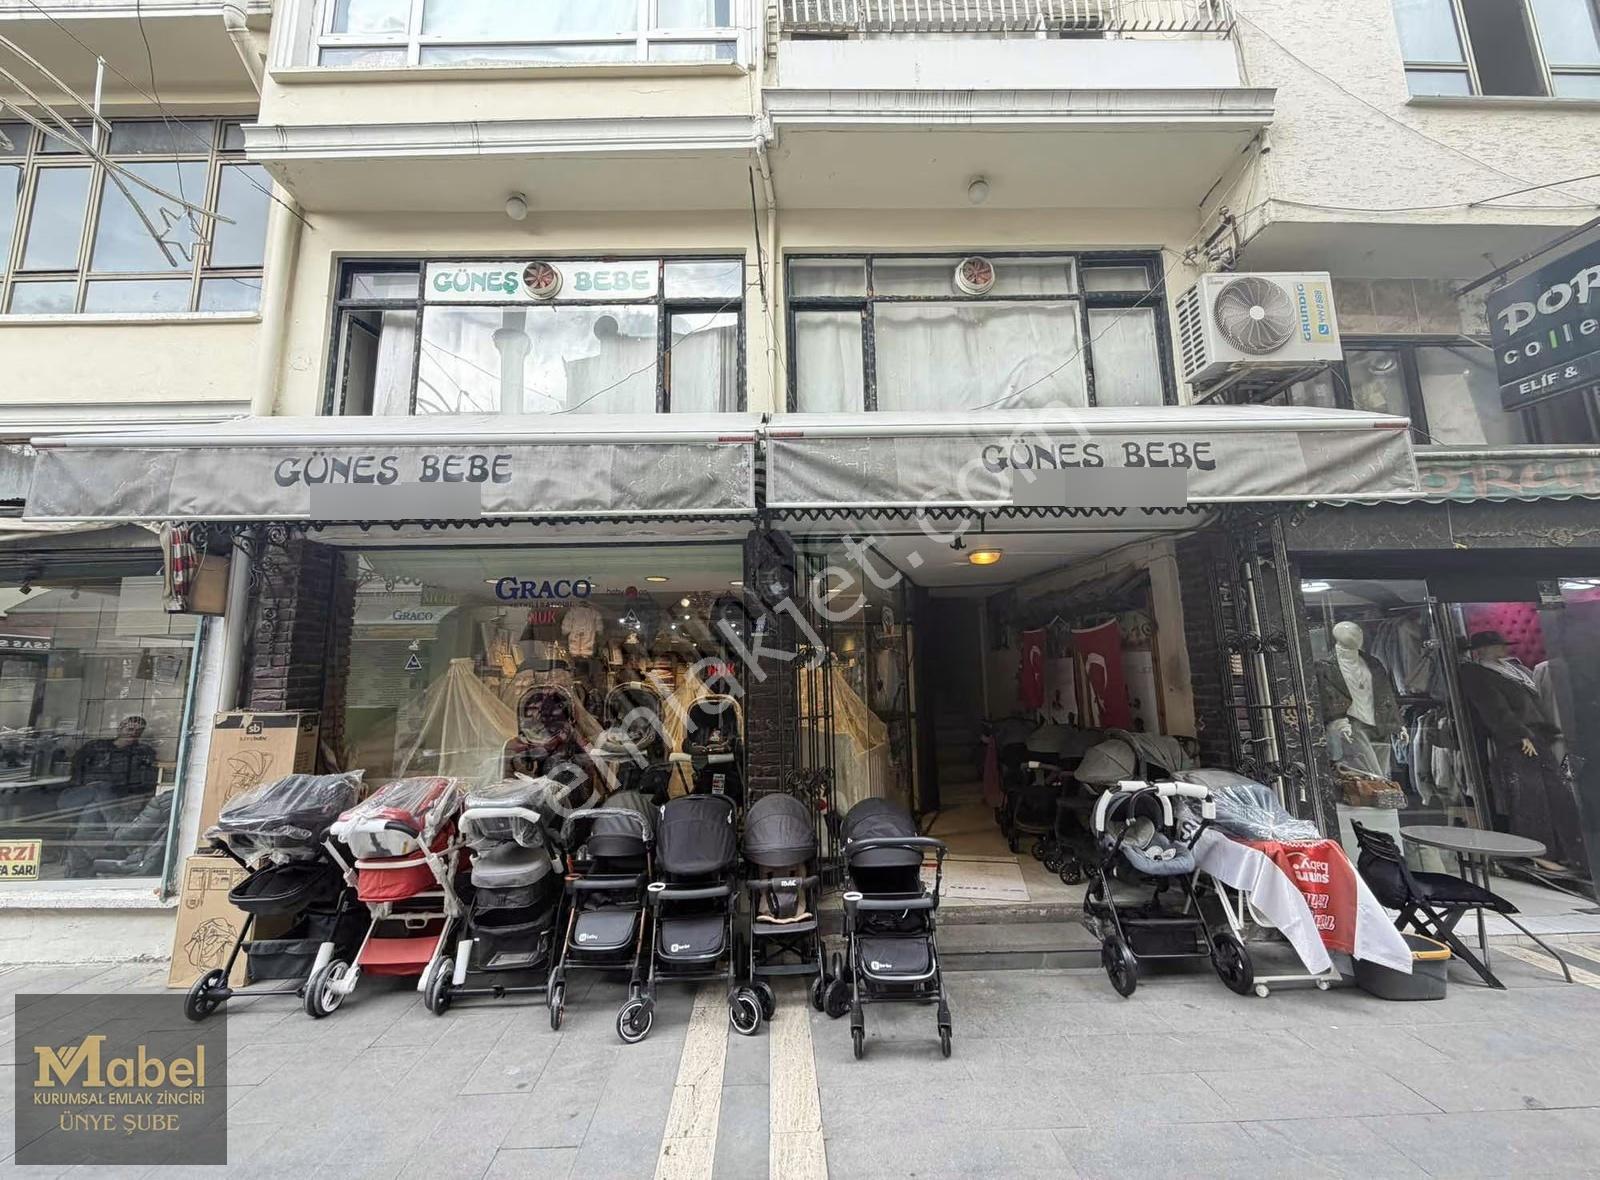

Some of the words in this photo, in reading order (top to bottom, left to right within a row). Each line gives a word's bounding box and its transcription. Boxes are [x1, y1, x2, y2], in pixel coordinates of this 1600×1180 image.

[433, 269, 519, 294] GÜNEŞ
[574, 270, 650, 291] BEBE
[1297, 283, 1312, 341] GRUNDIG
[1504, 318, 1599, 364] colle
[1519, 372, 1559, 394] ELİF
[1564, 366, 1578, 378] &
[419, 454, 513, 483] BEBE
[1121, 441, 1217, 471] BEBE
[496, 576, 592, 601] GRACO
[393, 609, 433, 620] GRACO
[528, 610, 557, 624] NUK
[247, 723, 261, 734] sb
[12, 865, 36, 876] SARI
